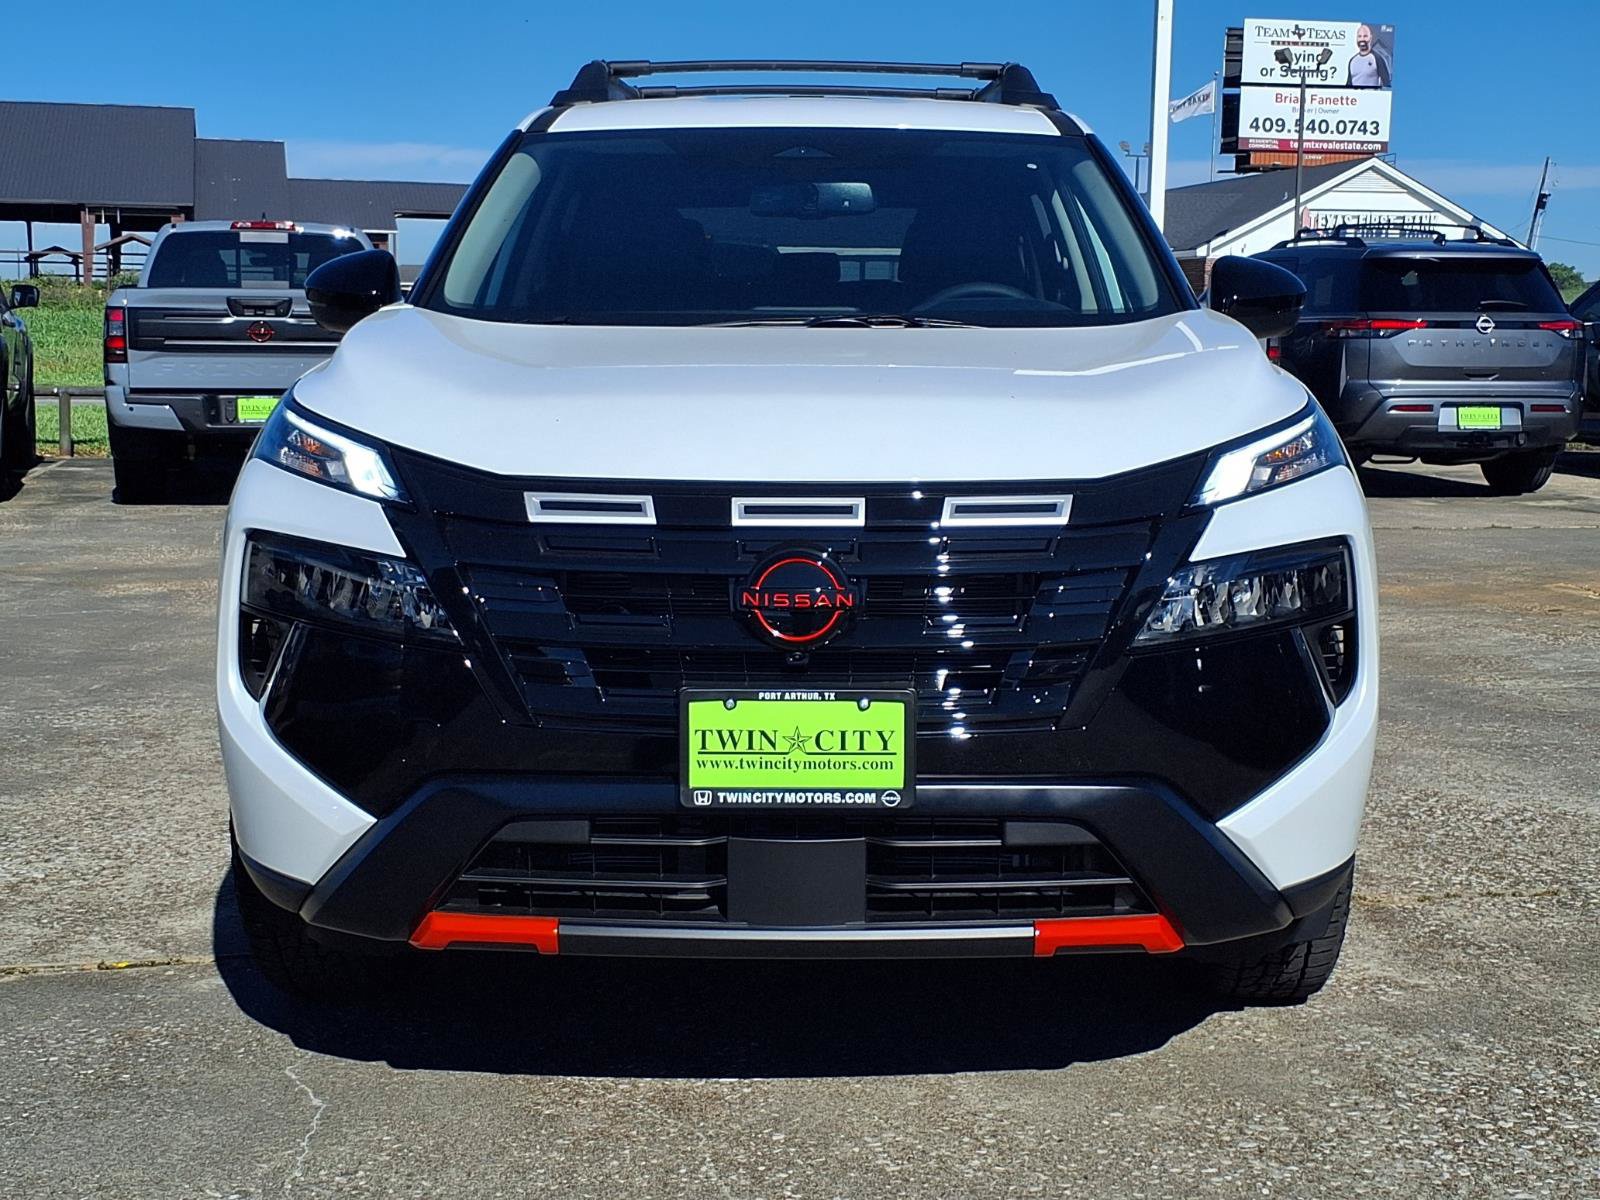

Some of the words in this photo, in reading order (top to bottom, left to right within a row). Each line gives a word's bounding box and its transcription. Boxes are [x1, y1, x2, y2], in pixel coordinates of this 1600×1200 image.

[1255, 26, 1290, 38] TEAM
[1307, 28, 1346, 39] TEXAS
[1260, 67, 1275, 77] or
[1280, 65, 1337, 81] Selling?
[1275, 92, 1304, 104] Bria
[1310, 94, 1358, 106] Fanette
[1249, 117, 1380, 136] 409.540.0743
[1289, 139, 1381, 151] temtxrealestate.com
[1408, 339, 1554, 348] PATHFINDER
[153, 361, 297, 378] FRONT
[742, 592, 853, 608] NISSAN
[758, 692, 782, 701] PORT
[824, 692, 836, 701] TX
[695, 729, 778, 752] TWIN
[814, 729, 896, 752] CITY
[696, 756, 894, 773] www.twincitymotors.com
[716, 792, 877, 805] TWINCITYMOTORS.COM
